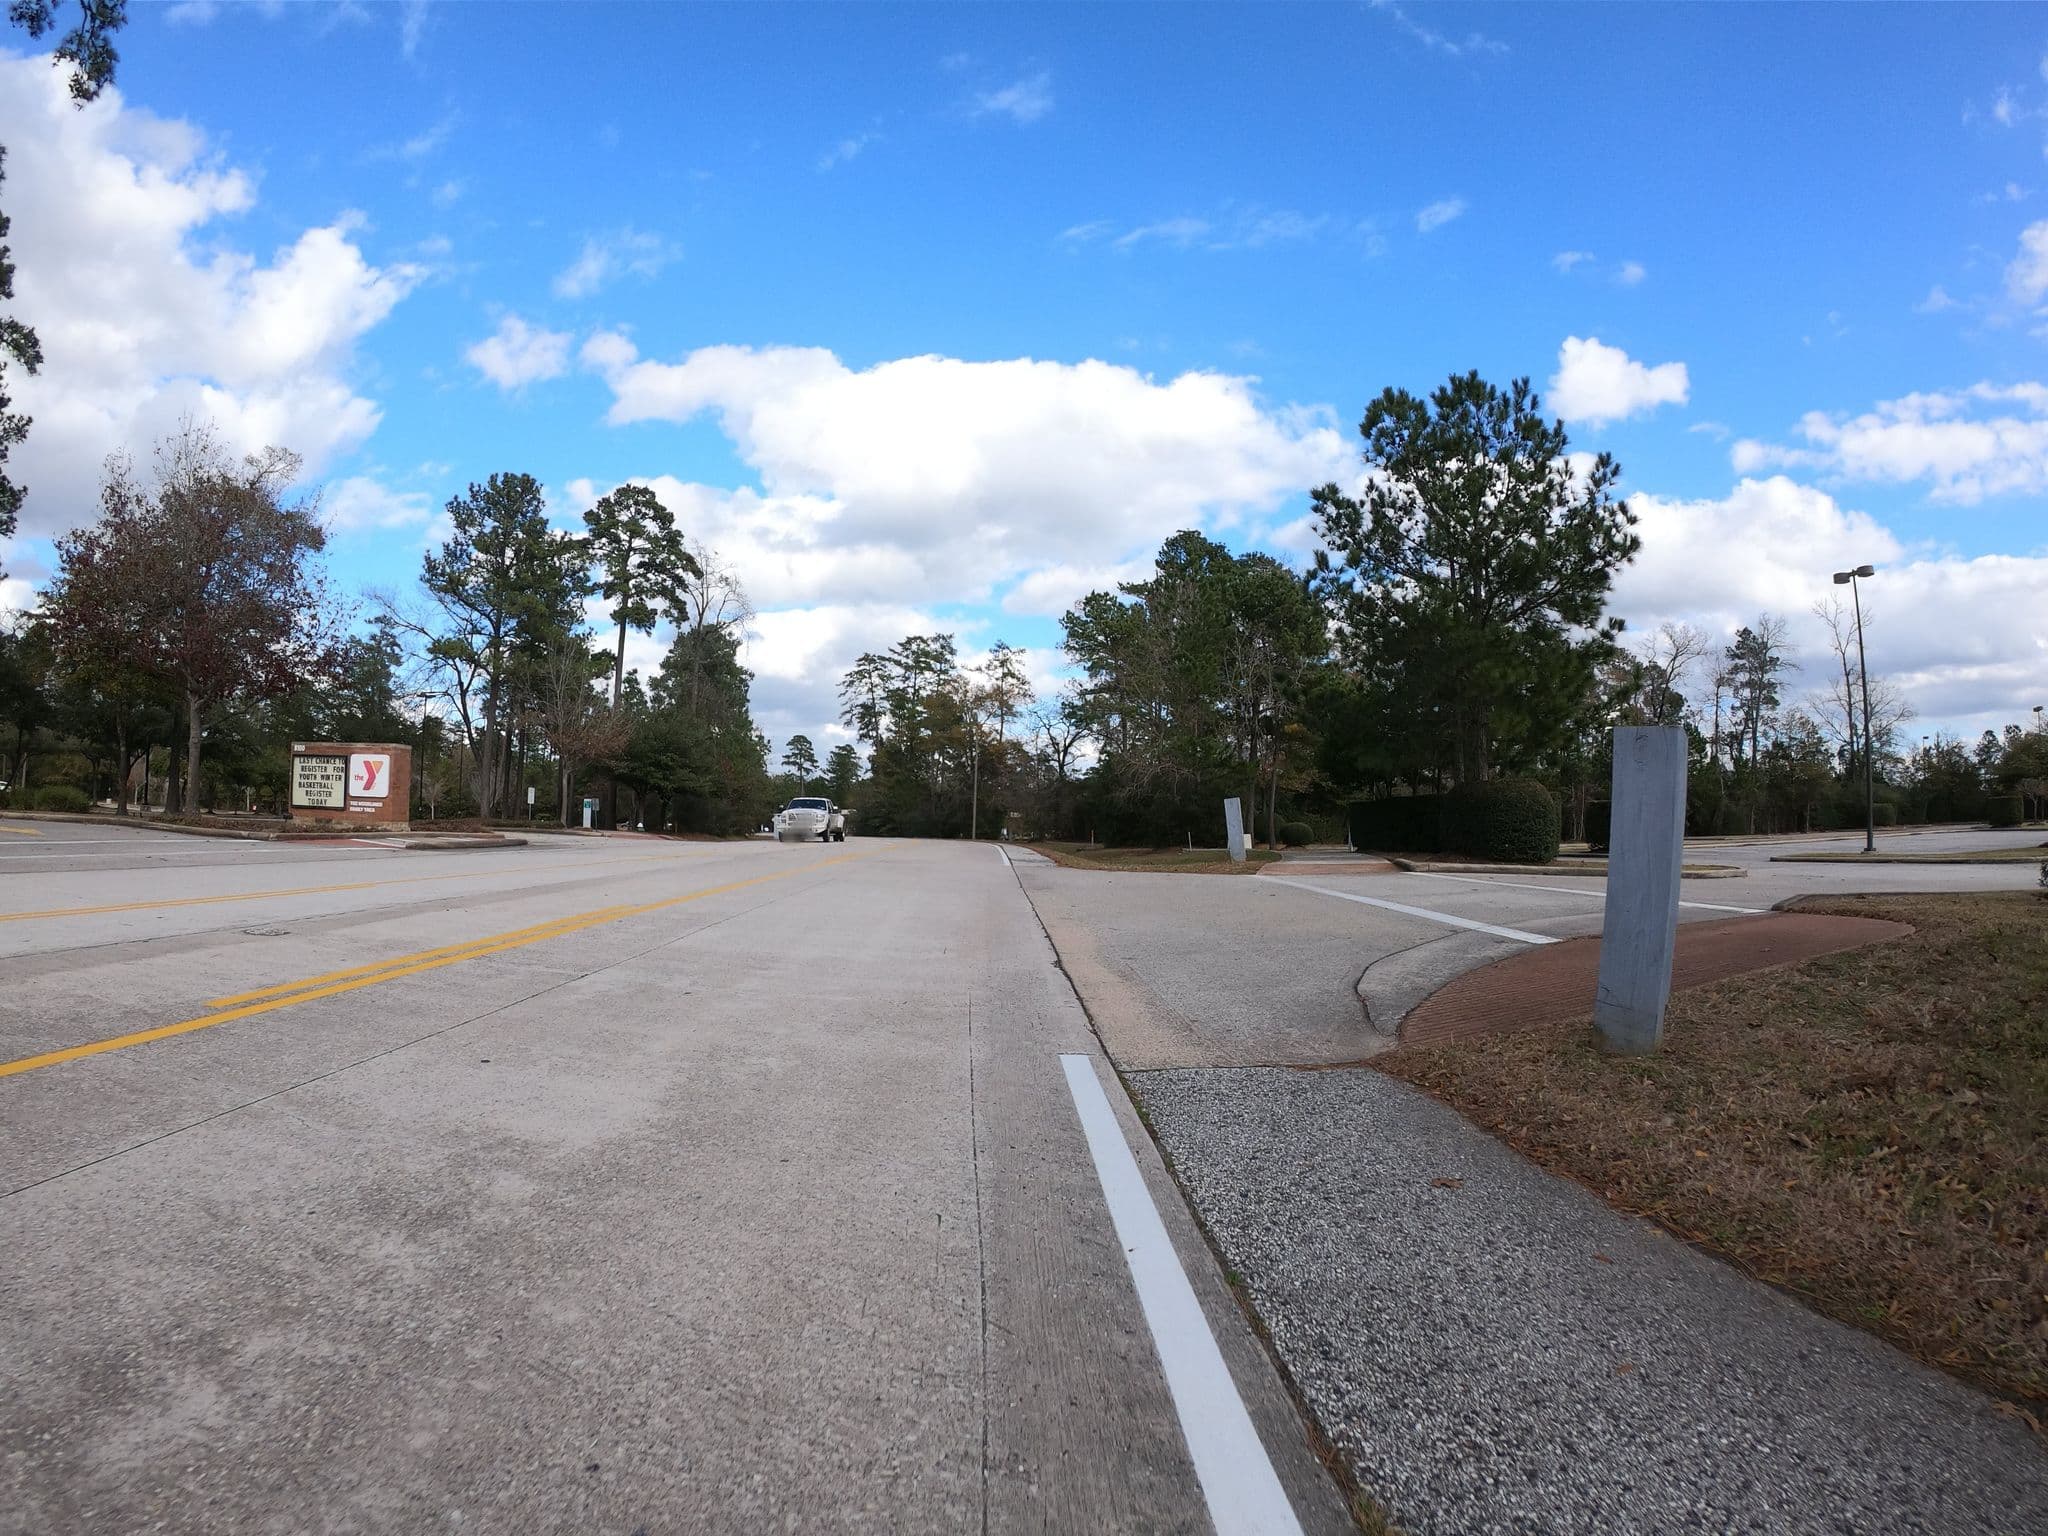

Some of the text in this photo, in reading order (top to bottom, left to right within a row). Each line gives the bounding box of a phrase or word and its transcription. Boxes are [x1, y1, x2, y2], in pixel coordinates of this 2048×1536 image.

[315, 757, 337, 765] CHANCE
[363, 760, 384, 790] Y
[308, 798, 327, 806] TODAY
